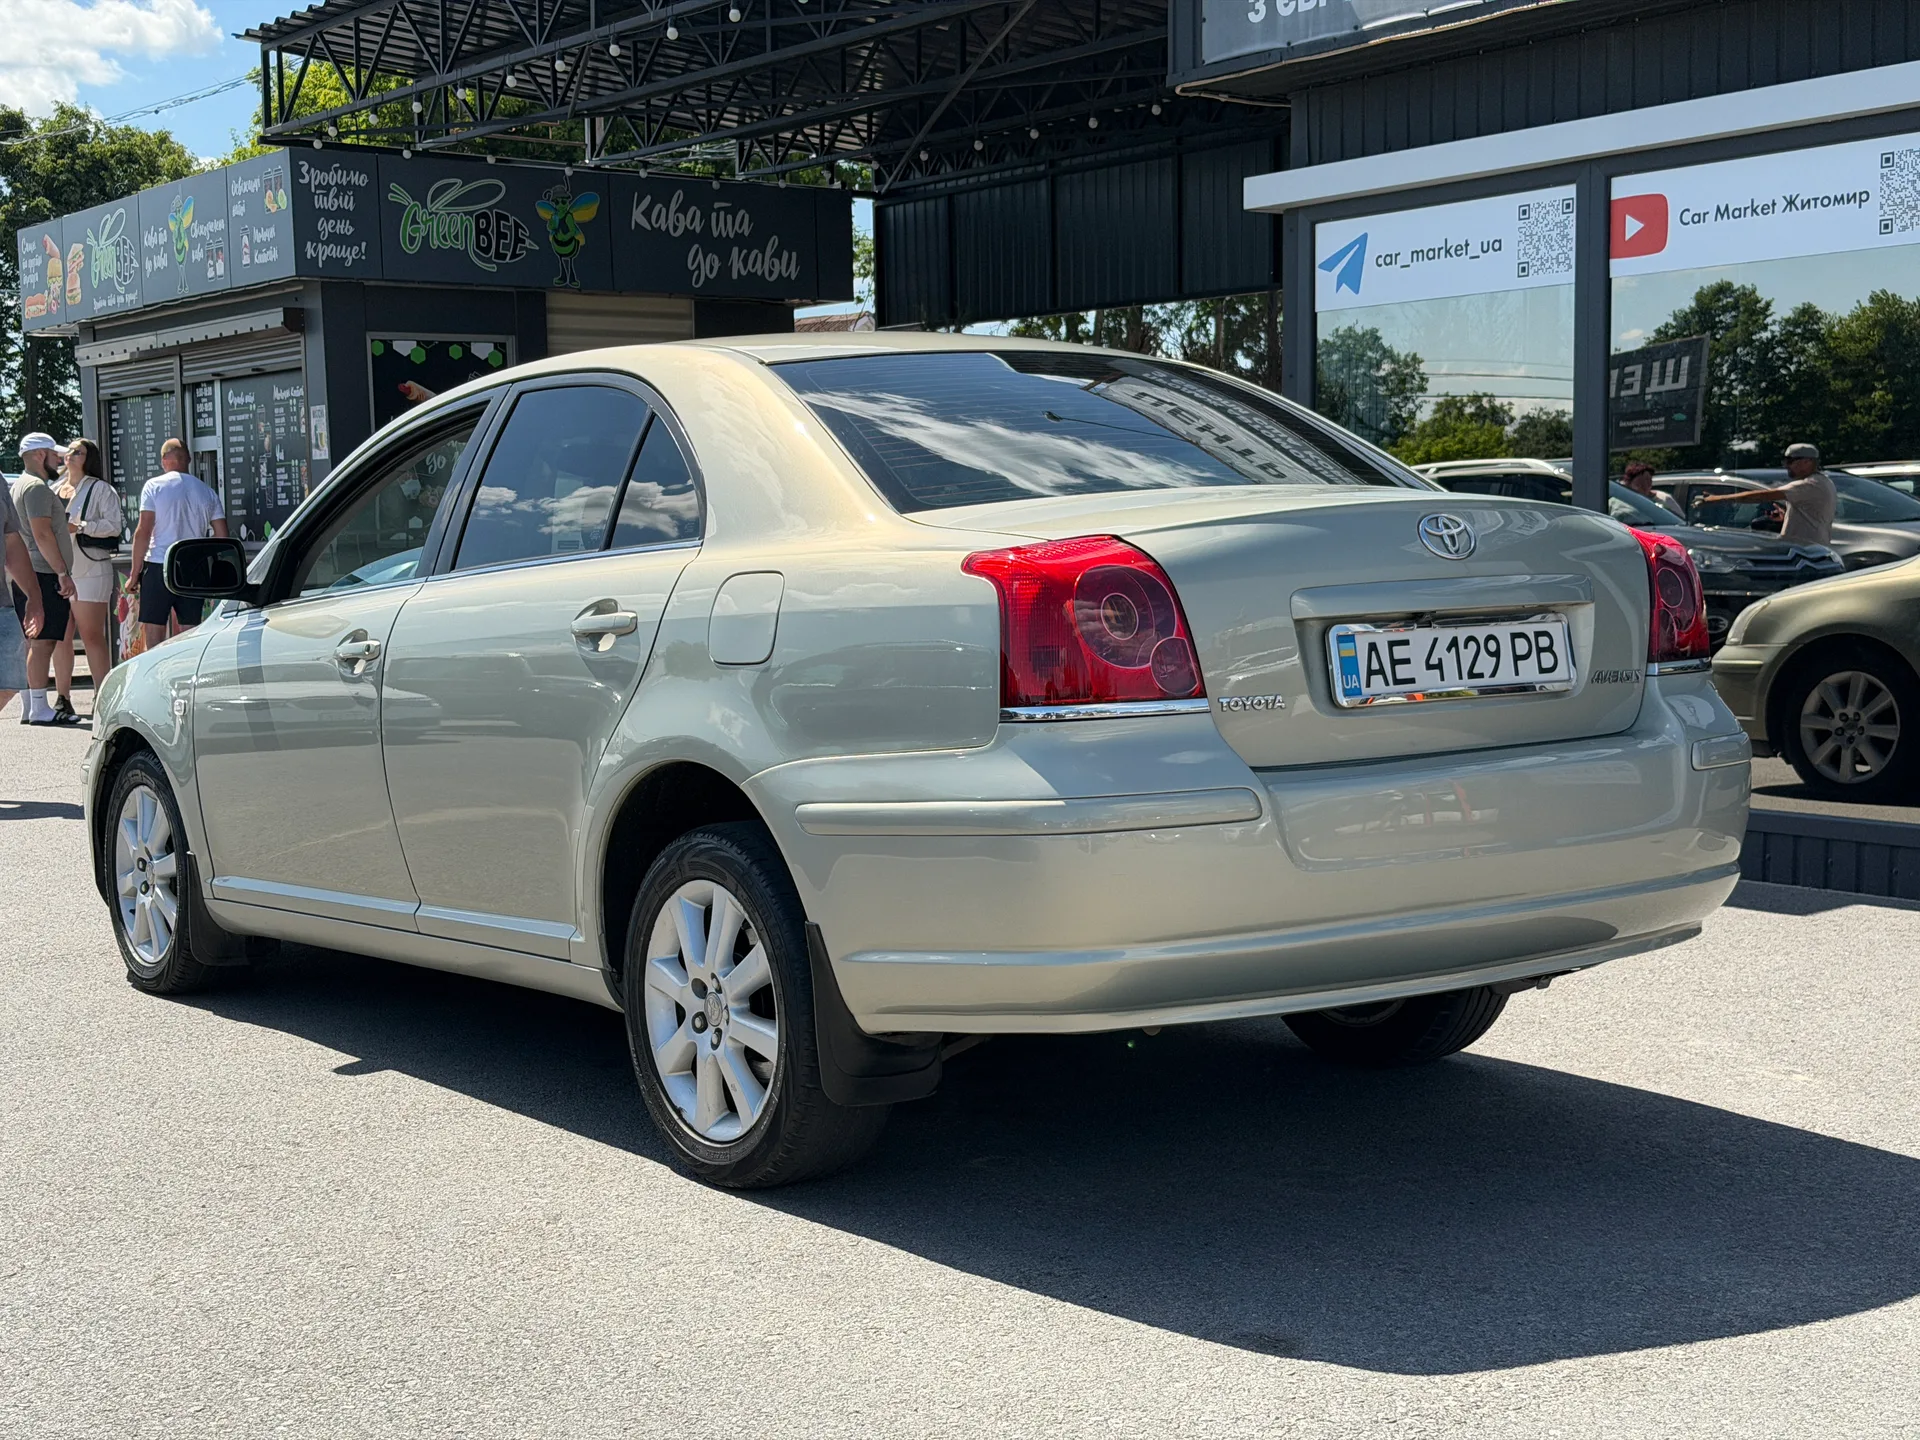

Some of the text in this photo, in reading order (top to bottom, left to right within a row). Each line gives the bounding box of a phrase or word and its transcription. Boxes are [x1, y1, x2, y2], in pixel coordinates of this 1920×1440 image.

[298, 160, 369, 190] Зробимо
[313, 189, 357, 212] твій
[631, 189, 753, 239] Кава та
[1678, 189, 1871, 227] Car Market Житомир
[317, 217, 355, 240] день
[304, 241, 367, 268] краще!
[687, 235, 800, 288] до кави
[1374, 237, 1502, 269] car_market_ua
[1365, 630, 1559, 688] AE 4129 PB
[1342, 680, 1360, 689] UA
[1217, 694, 1286, 712] TOYOTA
